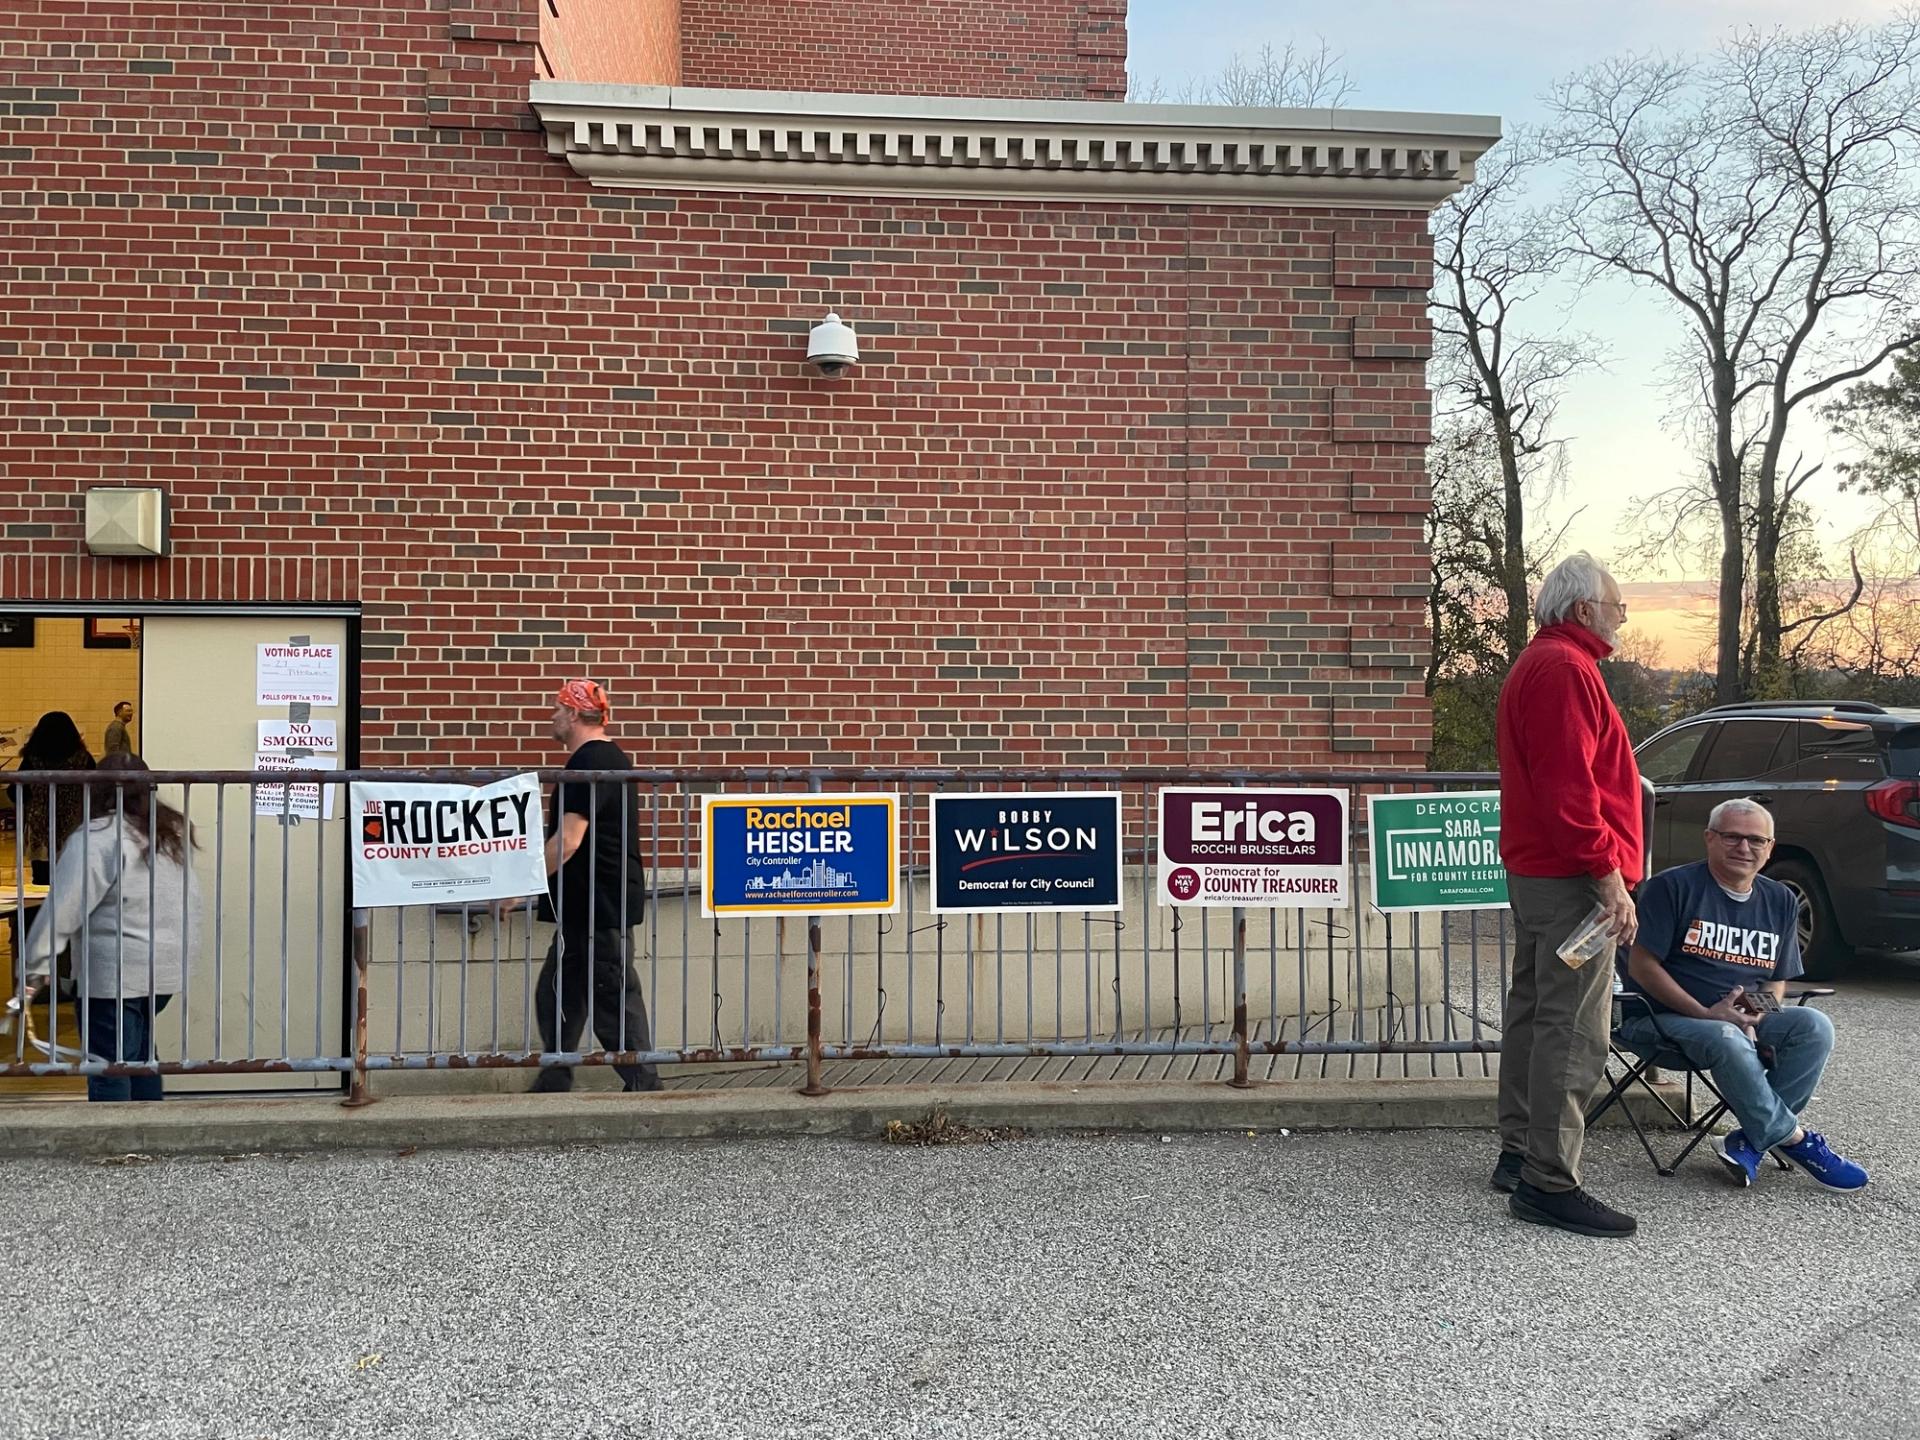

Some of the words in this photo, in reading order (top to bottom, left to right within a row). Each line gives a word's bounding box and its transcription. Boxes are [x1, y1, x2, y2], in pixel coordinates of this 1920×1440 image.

[265, 648, 300, 657] VOTING
[303, 649, 332, 657] PLACE
[290, 724, 311, 734] NO
[263, 736, 333, 746] SMOKING
[258, 756, 295, 764] VOTING
[257, 783, 318, 792] COMPAINTS
[363, 800, 383, 814] JOE
[383, 792, 530, 844] ROCKEY
[746, 806, 850, 829] Rachael
[999, 811, 1052, 824] BOBBY
[1191, 802, 1315, 842] Erica
[1445, 819, 1482, 837] SARA
[364, 847, 432, 860] COUNTY
[438, 838, 527, 857] EXECUTIVE
[746, 831, 854, 854] HEISLER
[1192, 844, 1236, 854] ROCCHI
[1240, 845, 1316, 855] BRUSSELARS
[746, 857, 761, 867] City
[763, 856, 802, 865] Controller
[1204, 867, 1260, 877] Democrat
[1264, 867, 1280, 876] for
[1411, 872, 1427, 882] FOR
[1432, 871, 1467, 882] COUNTY
[959, 880, 1008, 890] Democrat
[1012, 879, 1026, 889] for
[1030, 879, 1051, 892] City
[1055, 878, 1094, 888] Council
[1175, 879, 1193, 887] MAY
[1204, 878, 1258, 893] COUNTY
[1263, 879, 1338, 893] TREASURER
[745, 890, 858, 899] www.rachaelforcontroller.com
[1699, 921, 1780, 961] ROCKEY
[1682, 945, 1722, 960] COUNTY
[1725, 954, 1776, 969] EXECUTIVE
